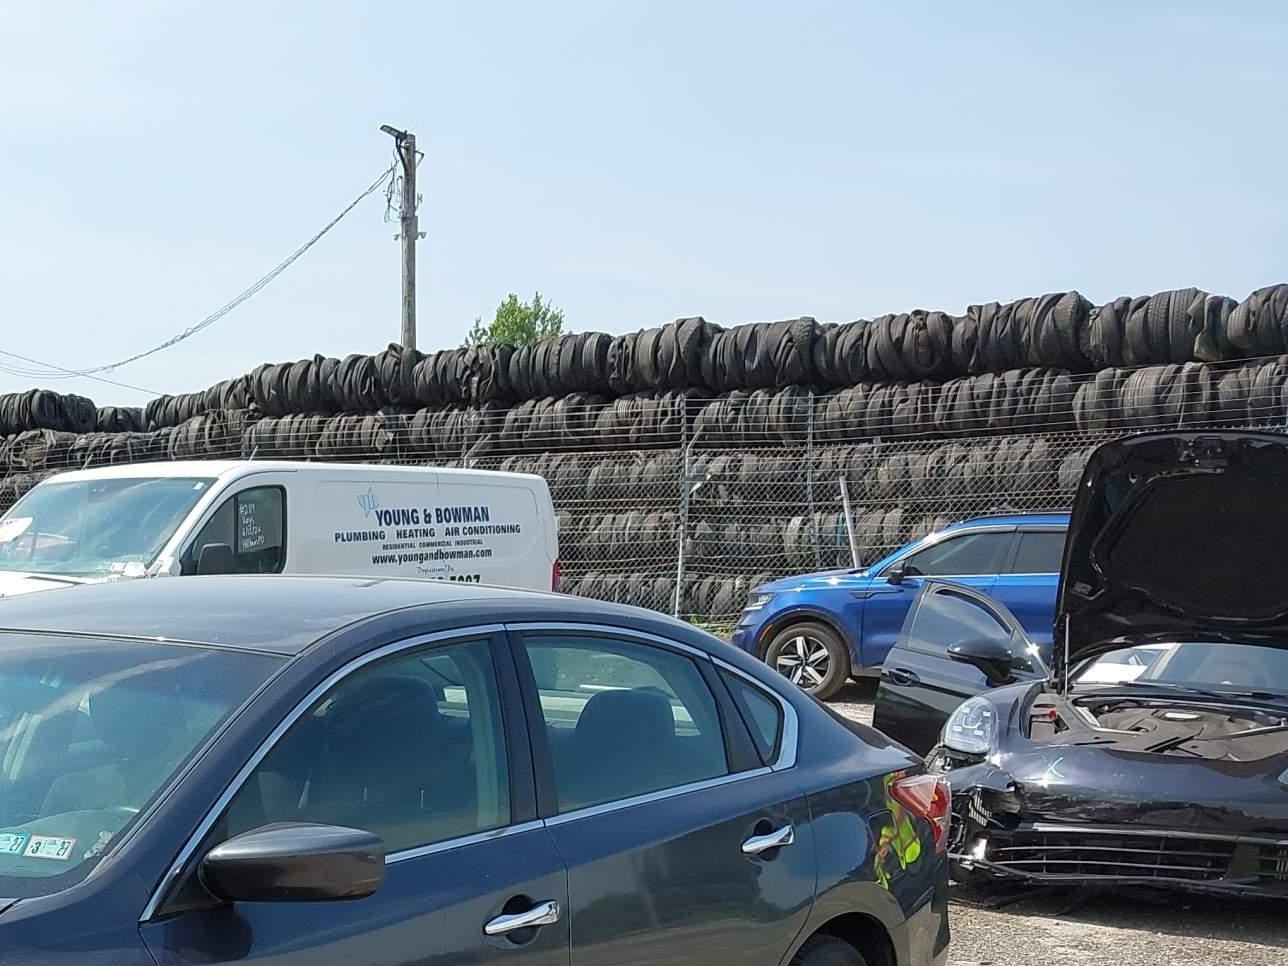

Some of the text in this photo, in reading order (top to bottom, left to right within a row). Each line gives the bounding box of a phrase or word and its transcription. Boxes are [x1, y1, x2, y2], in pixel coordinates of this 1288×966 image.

[376, 506, 489, 527] YOUNG & BOWMAN
[334, 524, 521, 543] PLUMBING HEATING AIR CONDITIONING
[382, 542, 416, 550] RESIDENTIAL
[372, 548, 492, 565] www.youngandbowman.com
[9, 836, 24, 852] 27
[56, 840, 71, 857] 27
